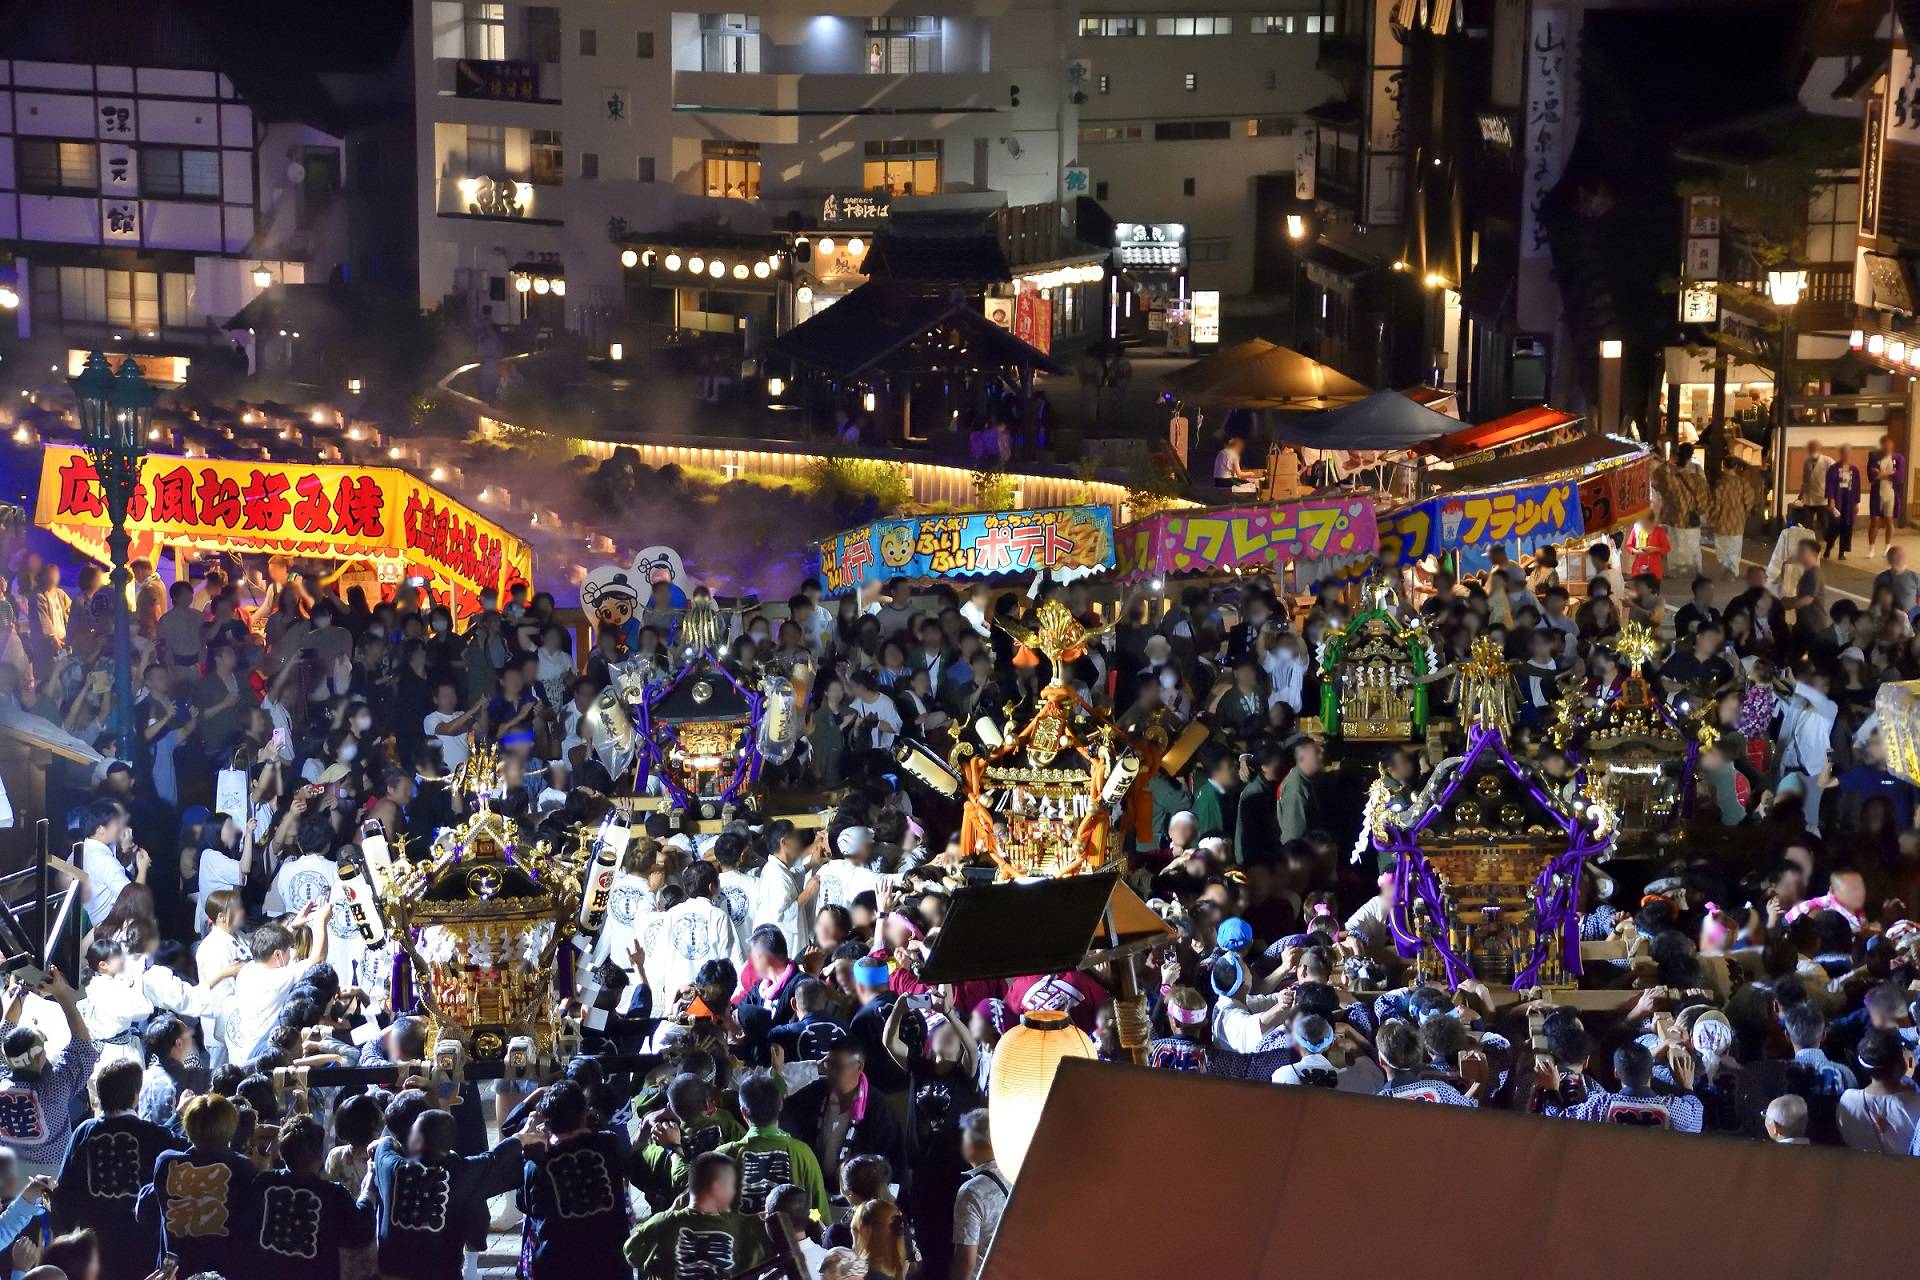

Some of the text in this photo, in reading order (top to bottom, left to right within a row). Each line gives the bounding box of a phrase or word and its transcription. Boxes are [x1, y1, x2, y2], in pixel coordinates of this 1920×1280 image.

[843, 204, 890, 218] 十割そば
[1183, 508, 1349, 563] クレープ
[1462, 485, 1570, 544] フラッペ
[975, 524, 1074, 570] ポテト
